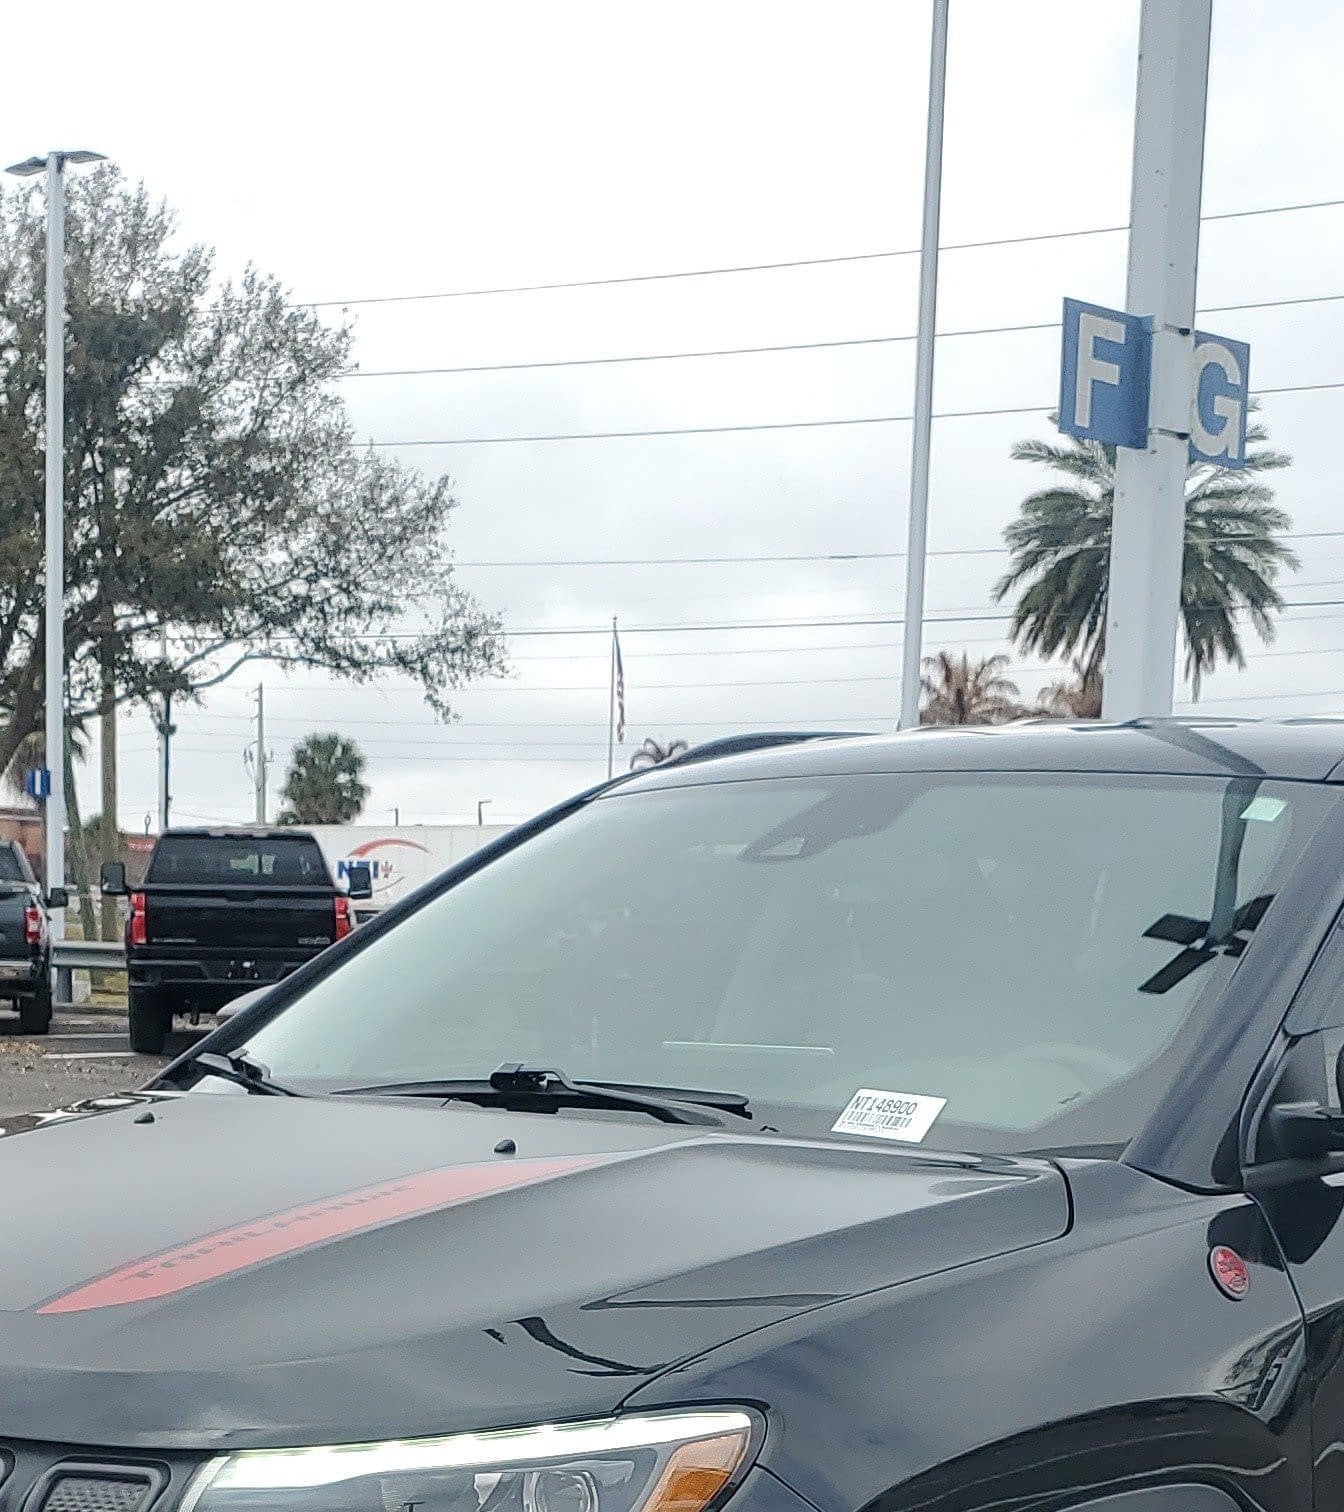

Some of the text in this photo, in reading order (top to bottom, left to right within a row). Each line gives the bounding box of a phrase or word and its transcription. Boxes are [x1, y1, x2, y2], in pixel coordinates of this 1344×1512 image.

[1074, 312, 1127, 429] F
[1190, 342, 1242, 460] G
[851, 1096, 918, 1115] NT148900
